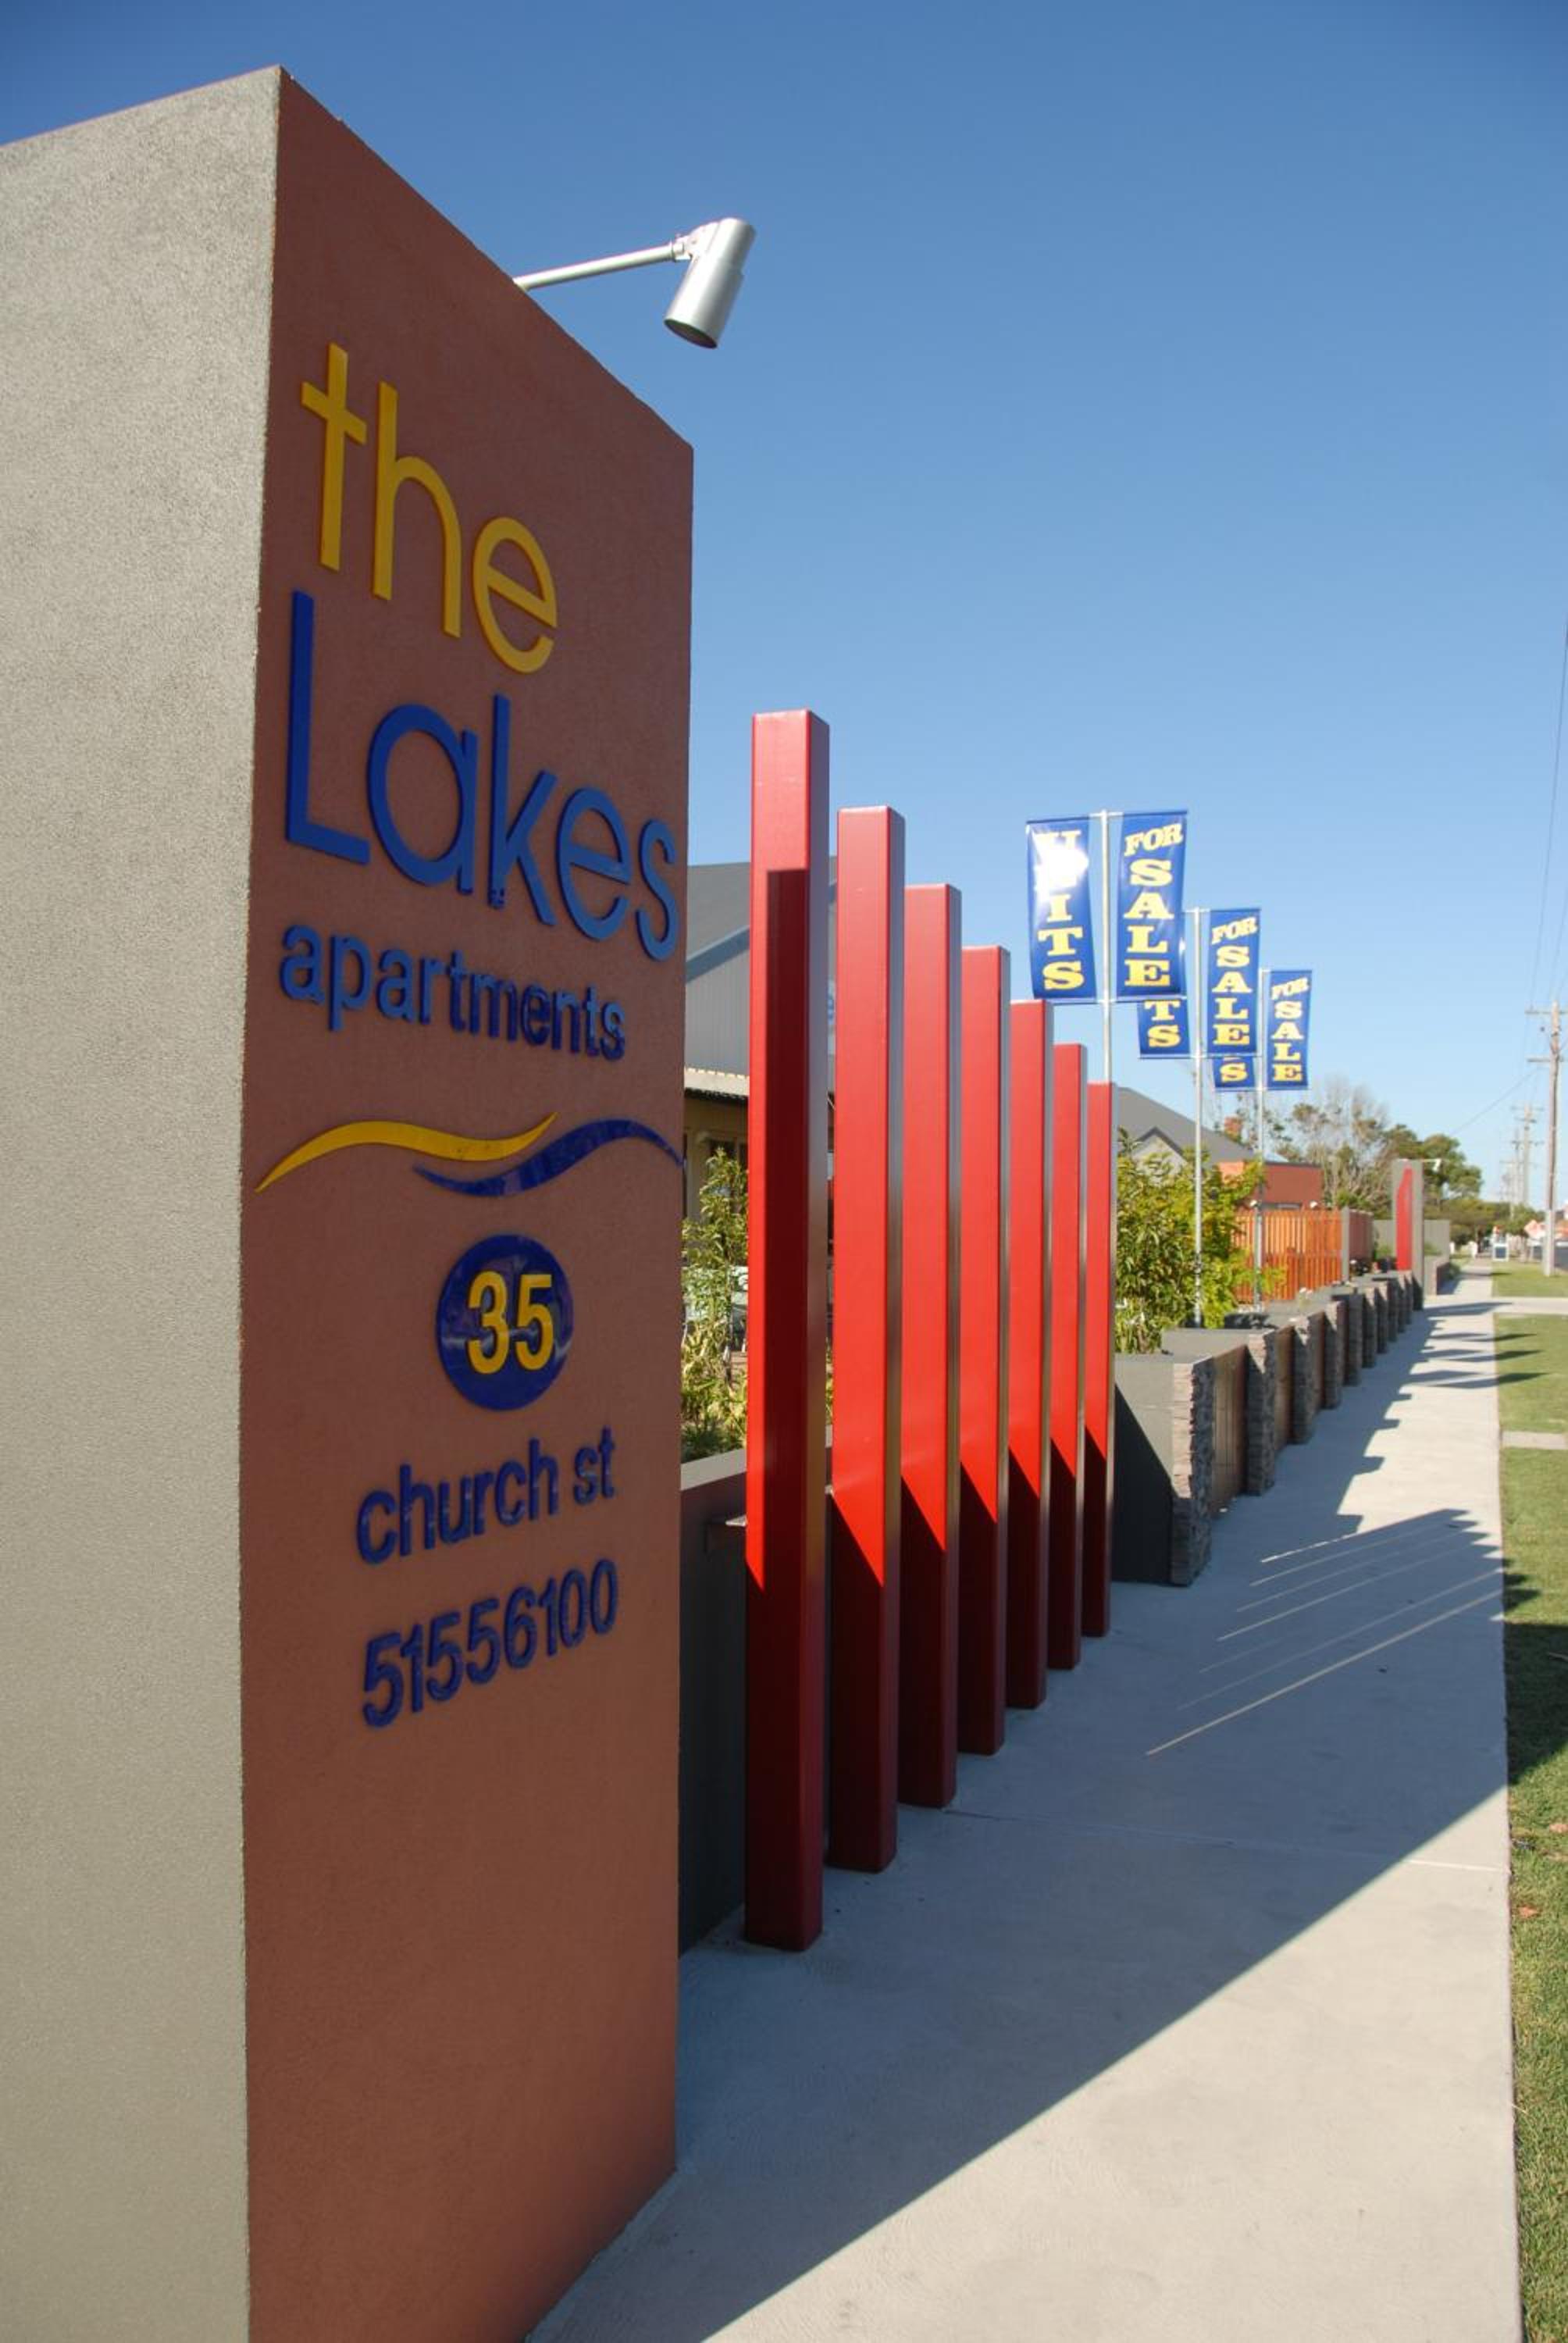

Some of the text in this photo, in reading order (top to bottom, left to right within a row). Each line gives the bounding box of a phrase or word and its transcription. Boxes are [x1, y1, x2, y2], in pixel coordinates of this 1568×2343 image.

[301, 341, 558, 674] the
[284, 590, 680, 963] Lakes
[1124, 822, 1184, 856] FOR
[1123, 859, 1174, 986] SALE
[1211, 916, 1258, 945] FOR
[279, 925, 625, 1061] apartments
[1212, 946, 1253, 1047] SALE
[1270, 977, 1309, 1000] FOR
[1270, 1001, 1304, 1082] SALE
[467, 1271, 554, 1375] 35
[356, 1426, 615, 1565] church st
[362, 1559, 618, 1728] 51556100
